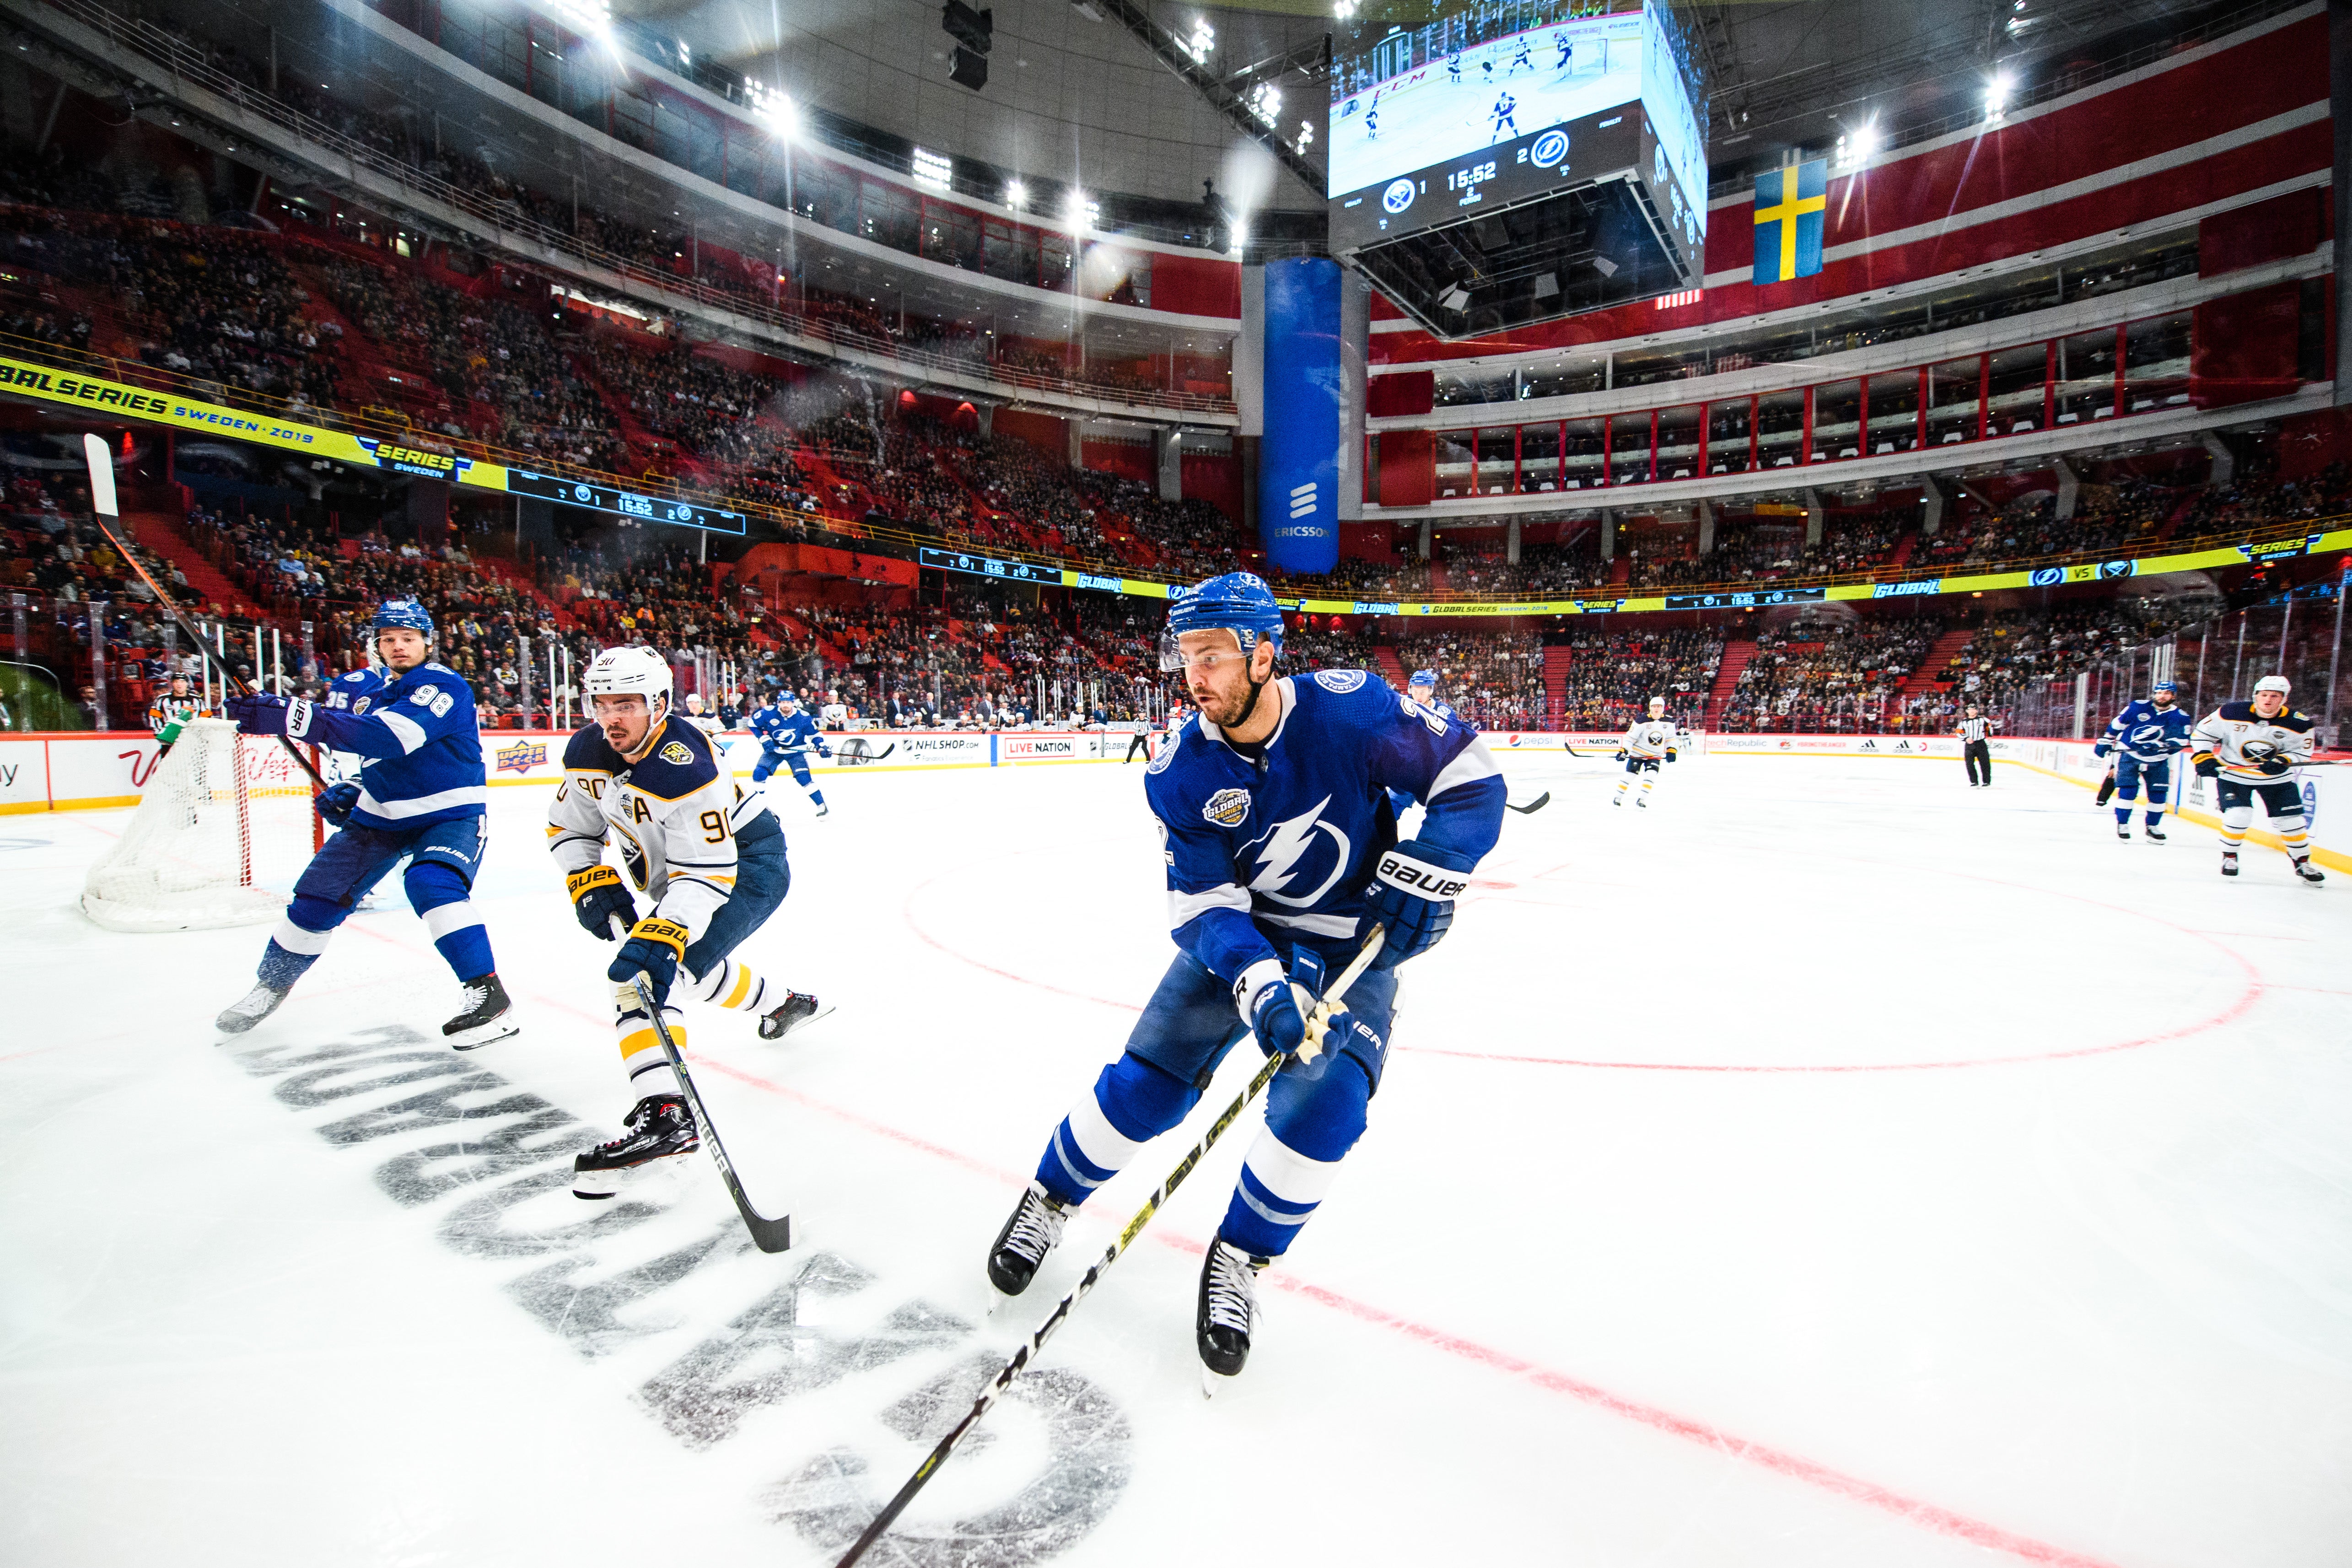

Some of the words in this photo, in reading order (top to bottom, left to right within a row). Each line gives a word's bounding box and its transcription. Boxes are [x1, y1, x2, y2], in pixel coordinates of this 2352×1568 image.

[1517, 147, 1528, 164] 2
[1448, 160, 1496, 191] 15:52
[1420, 180, 1426, 194] 1
[1466, 186, 1474, 197] 2
[1459, 193, 1482, 206] PERIOD
[174, 406, 259, 431] SWEDEN
[269, 427, 314, 444] 2019
[375, 444, 455, 470] SERIES
[393, 463, 445, 478] SWEDEN
[595, 495, 600, 506] 1
[618, 499, 653, 517] 15:52
[667, 509, 675, 520] 2
[1274, 526, 1330, 538] ERICSSON
[2249, 538, 2306, 555] SERIES
[984, 564, 1005, 575] 15:52
[2074, 567, 2089, 579] VS
[1077, 575, 1122, 593] GLOBAL
[1874, 581, 1938, 598] GLOBAL
[1582, 600, 1616, 609] SERIES
[1731, 596, 1755, 605] 15:52
[1172, 606, 1196, 615] BAUER
[1353, 603, 1398, 615] GLOBAL
[325, 691, 349, 710] 35
[409, 683, 454, 718] 98
[2234, 724, 2249, 733] 37
[916, 739, 980, 750] NHLSHOP.COM
[1009, 743, 1033, 753] LIVE
[1035, 742, 1071, 752] NATION
[1523, 736, 1553, 746] pepsi
[499, 747, 544, 760] UPPER
[664, 744, 685, 758] 50
[577, 777, 607, 800] 90
[633, 796, 654, 825] A
[1207, 793, 1248, 818] GLOBAL
[1215, 804, 1243, 820] SERIES
[1222, 811, 1241, 821] SWEDEN
[424, 846, 471, 864] BAUER
[1379, 858, 1467, 896] BAUER
[688, 1099, 729, 1174] BAUER
[229, 1023, 1136, 1568] GATORADE
